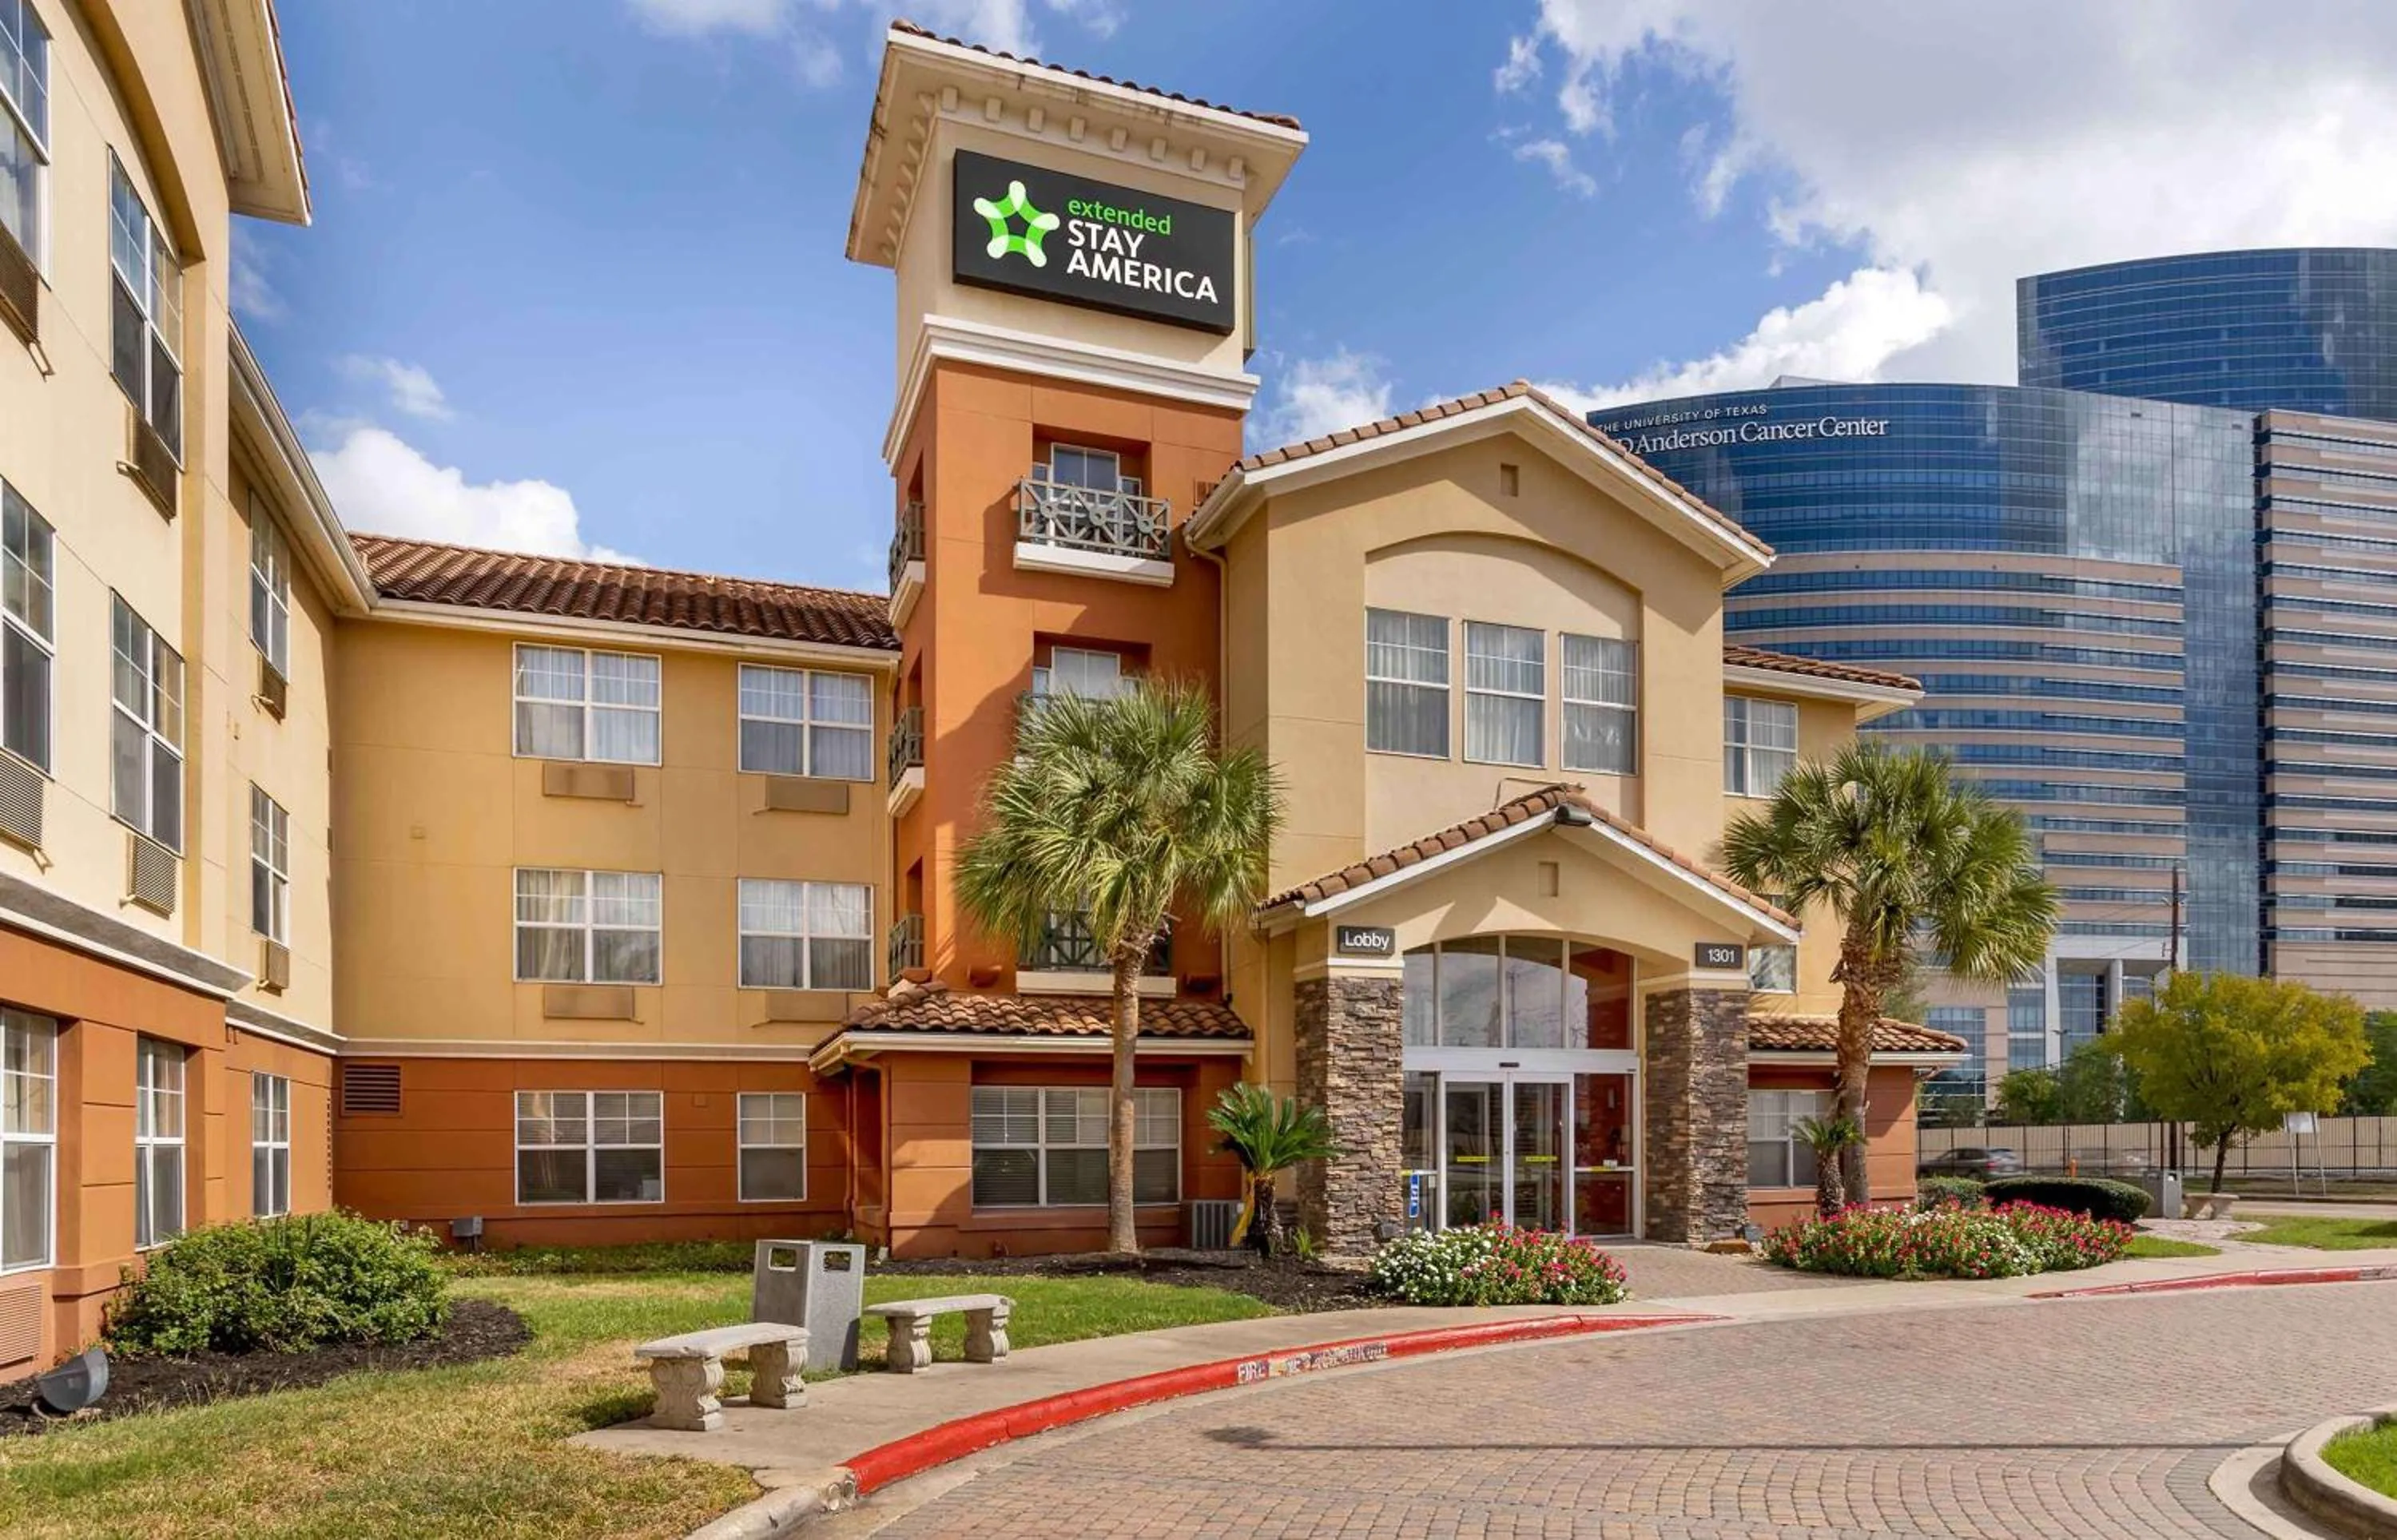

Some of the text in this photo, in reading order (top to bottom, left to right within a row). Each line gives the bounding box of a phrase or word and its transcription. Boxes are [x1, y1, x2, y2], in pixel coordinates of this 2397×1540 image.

[1067, 197, 1171, 236] extended
[1067, 219, 1145, 258] STAY
[1066, 248, 1219, 304] AMERICA
[1624, 411, 1700, 431] UNIVERSITY
[1704, 408, 1720, 419] OF
[1725, 404, 1768, 416] TEXAS
[1635, 428, 1737, 454] Anderson
[1740, 420, 1818, 443] Cancer
[1819, 415, 1889, 438] Center
[1345, 930, 1389, 951] Lobby
[1707, 948, 1735, 963] 1301
